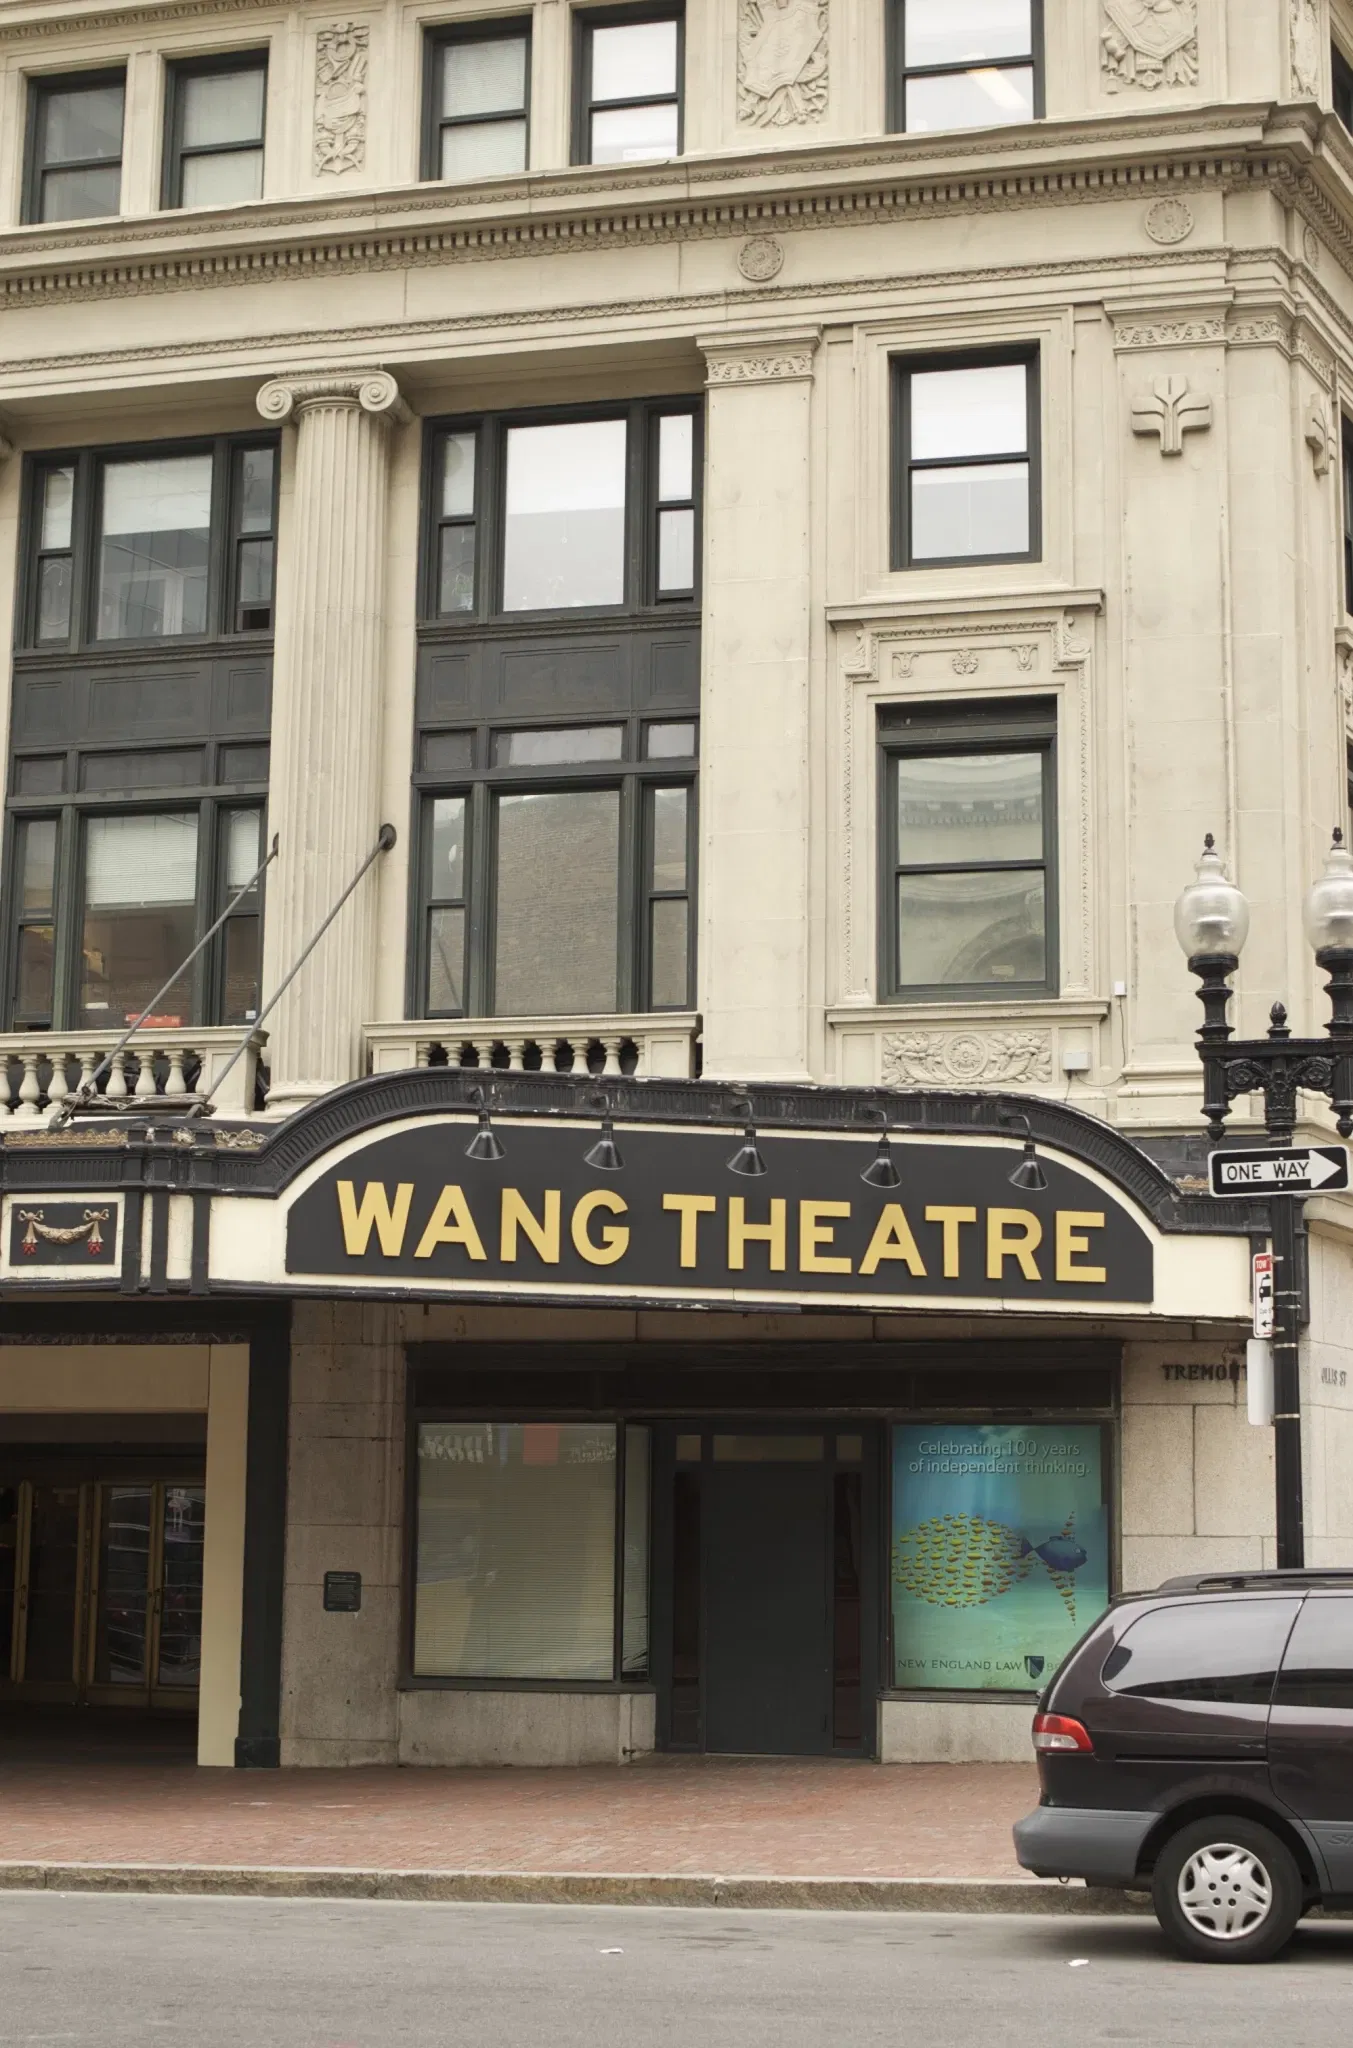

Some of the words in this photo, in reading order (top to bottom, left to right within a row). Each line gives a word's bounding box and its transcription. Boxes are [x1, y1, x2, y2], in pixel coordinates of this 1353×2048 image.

[1227, 1164, 1262, 1181] ONE
[1273, 1161, 1309, 1179] WAY
[336, 1180, 630, 1266] WANG
[663, 1193, 1106, 1283] THEATRE
[918, 1441, 1001, 1459] Celebrating
[1006, 1440, 1037, 1456] 100
[1042, 1444, 1080, 1459] years
[909, 1459, 926, 1473] of
[927, 1460, 1020, 1476] independent
[1025, 1460, 1091, 1477] thinking.
[897, 1659, 927, 1669] NEW
[931, 1659, 992, 1670] ENGLAND
[995, 1660, 1022, 1671] LAW
